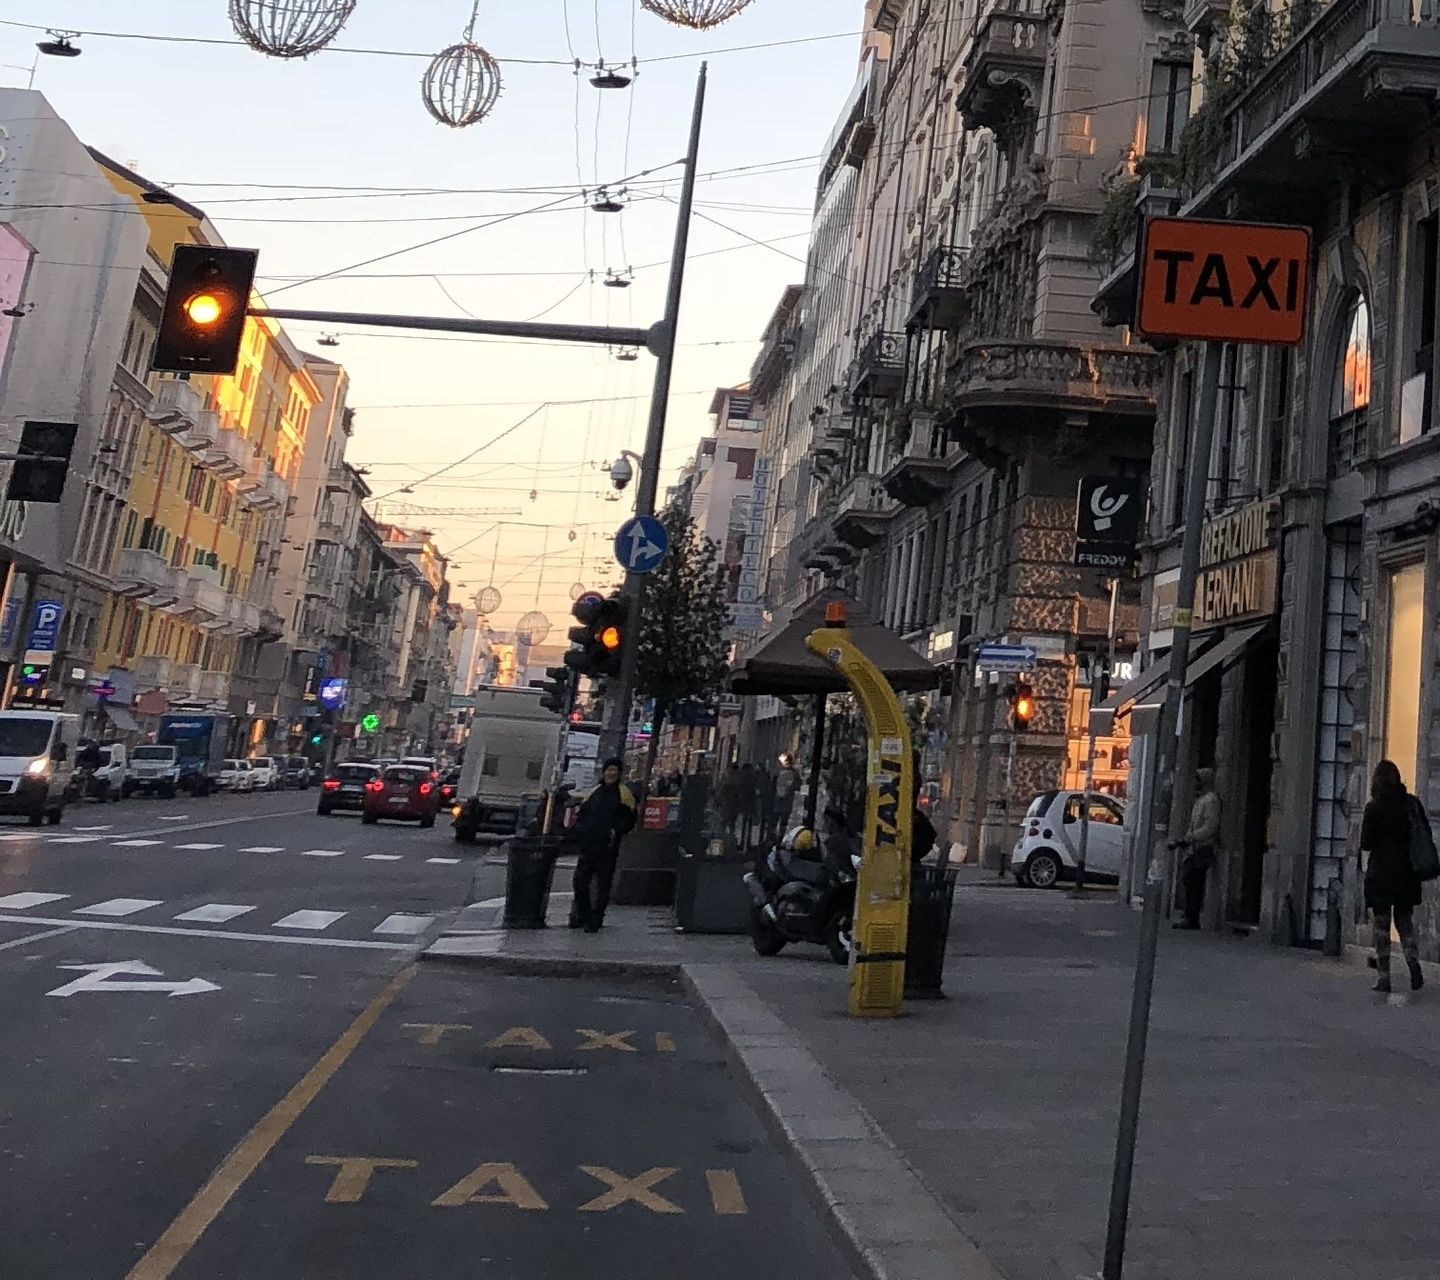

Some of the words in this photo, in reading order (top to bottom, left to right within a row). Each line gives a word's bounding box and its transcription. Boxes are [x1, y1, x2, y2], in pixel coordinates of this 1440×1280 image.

[1153, 249, 1300, 312] TAXI
[1077, 553, 1127, 567] FREDDY
[37, 608, 57, 629] P
[874, 758, 902, 846] TAXI
[402, 1022, 677, 1053] TAXI
[304, 1155, 748, 1215] TAXI
